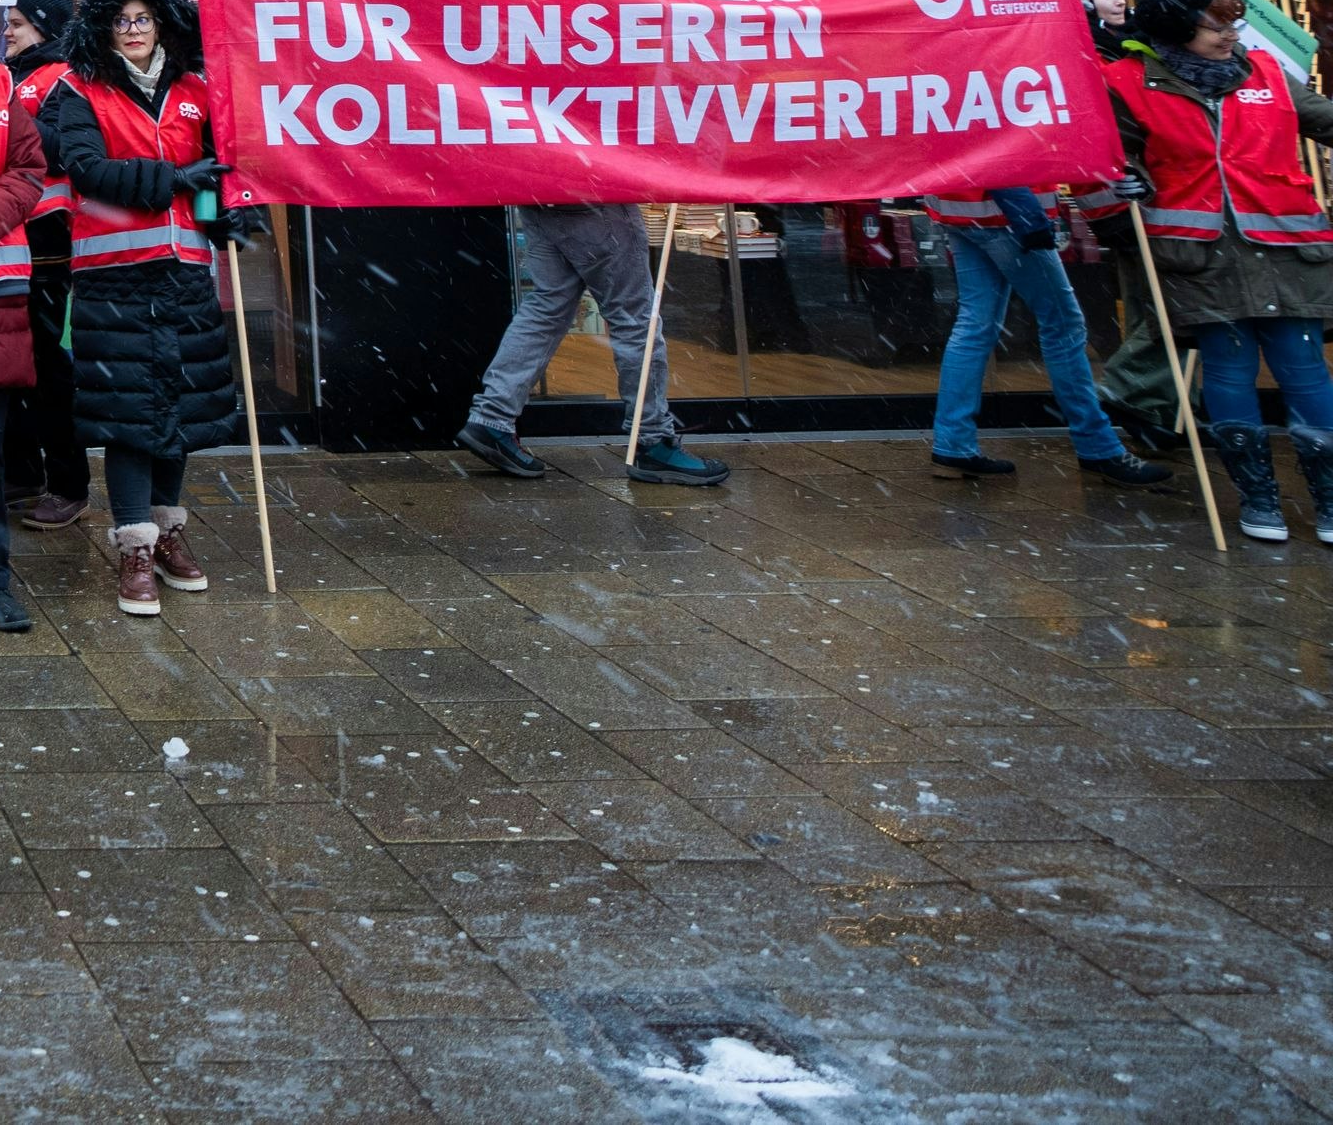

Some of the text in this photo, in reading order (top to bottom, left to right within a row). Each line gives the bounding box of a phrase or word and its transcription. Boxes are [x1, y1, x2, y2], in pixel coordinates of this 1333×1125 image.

[990, 1, 1060, 15] GEWERKSCHAFT
[442, 3, 824, 65] UNSEREN
[260, 64, 1071, 146] KOLLEKTIVVERTRAG!
[1235, 88, 1275, 104] gpa
